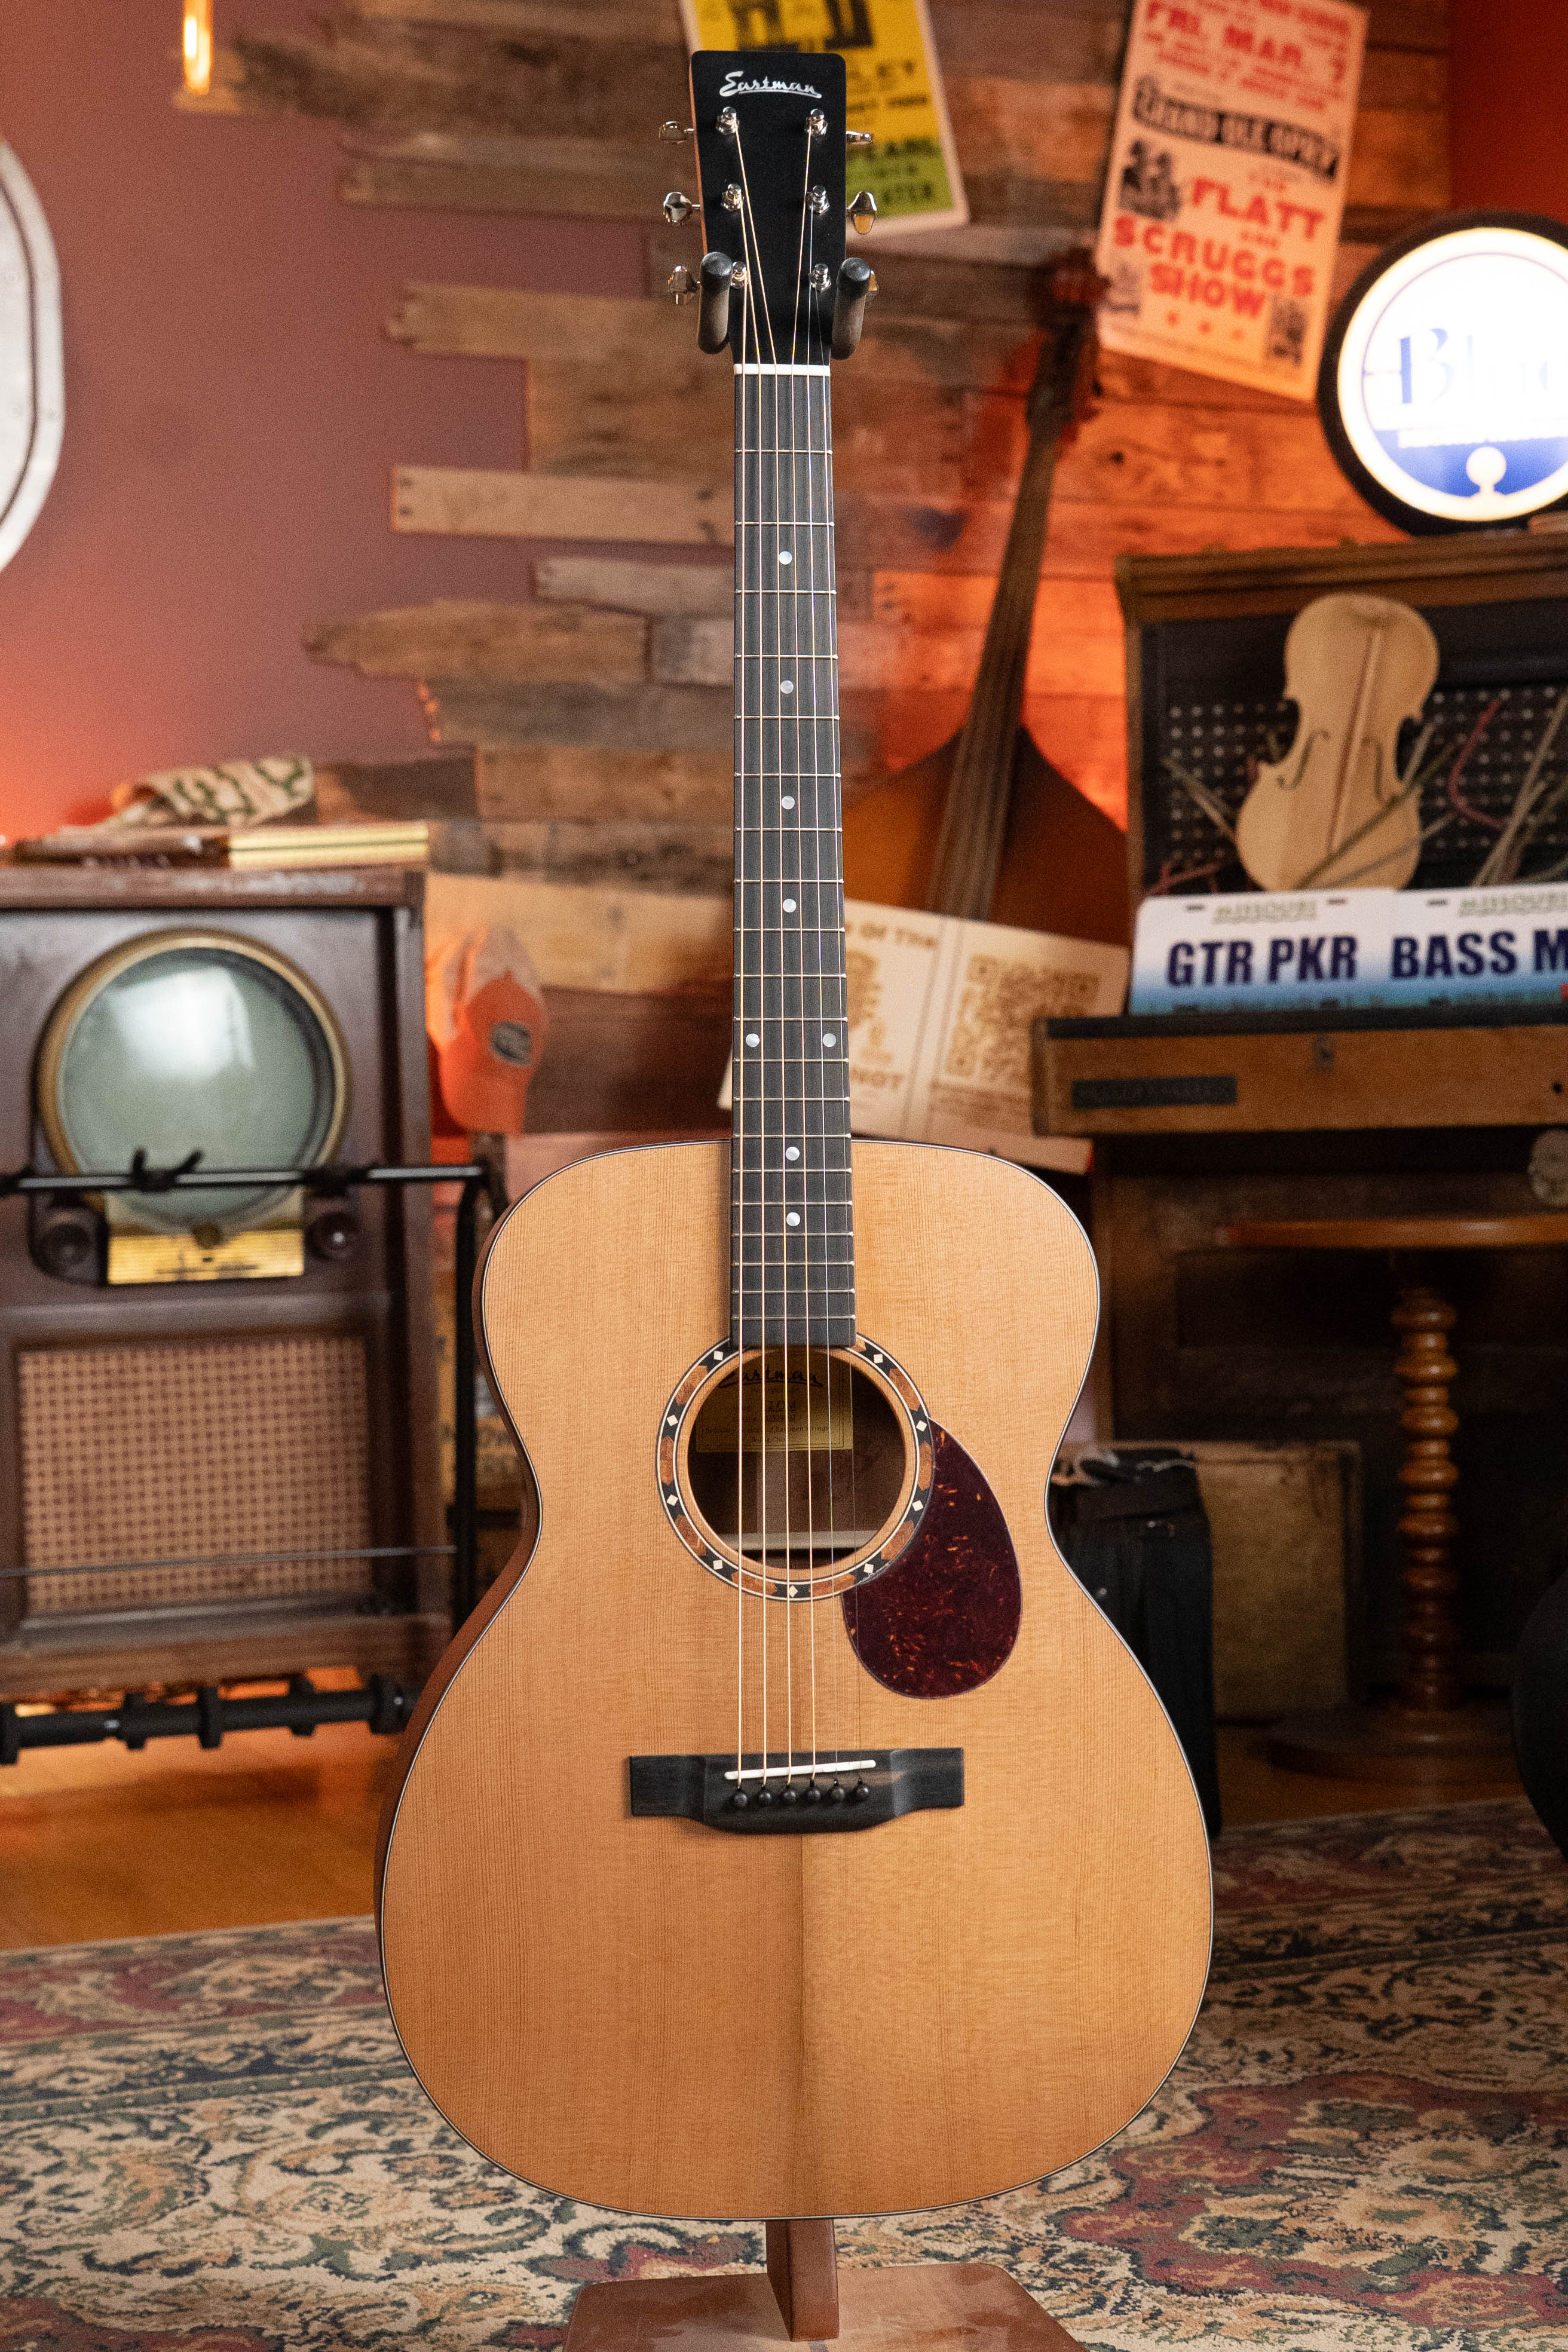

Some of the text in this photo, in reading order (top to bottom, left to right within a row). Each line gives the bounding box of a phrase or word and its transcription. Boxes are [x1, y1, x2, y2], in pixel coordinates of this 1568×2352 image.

[719, 71, 822, 98] Eastman
[1193, 178, 1325, 239] FLATT
[1114, 216, 1313, 298] SCRUGGS
[1150, 263, 1266, 319] SHOW
[1167, 934, 1358, 988] GTR PKR
[1391, 930, 1518, 979] BASS
